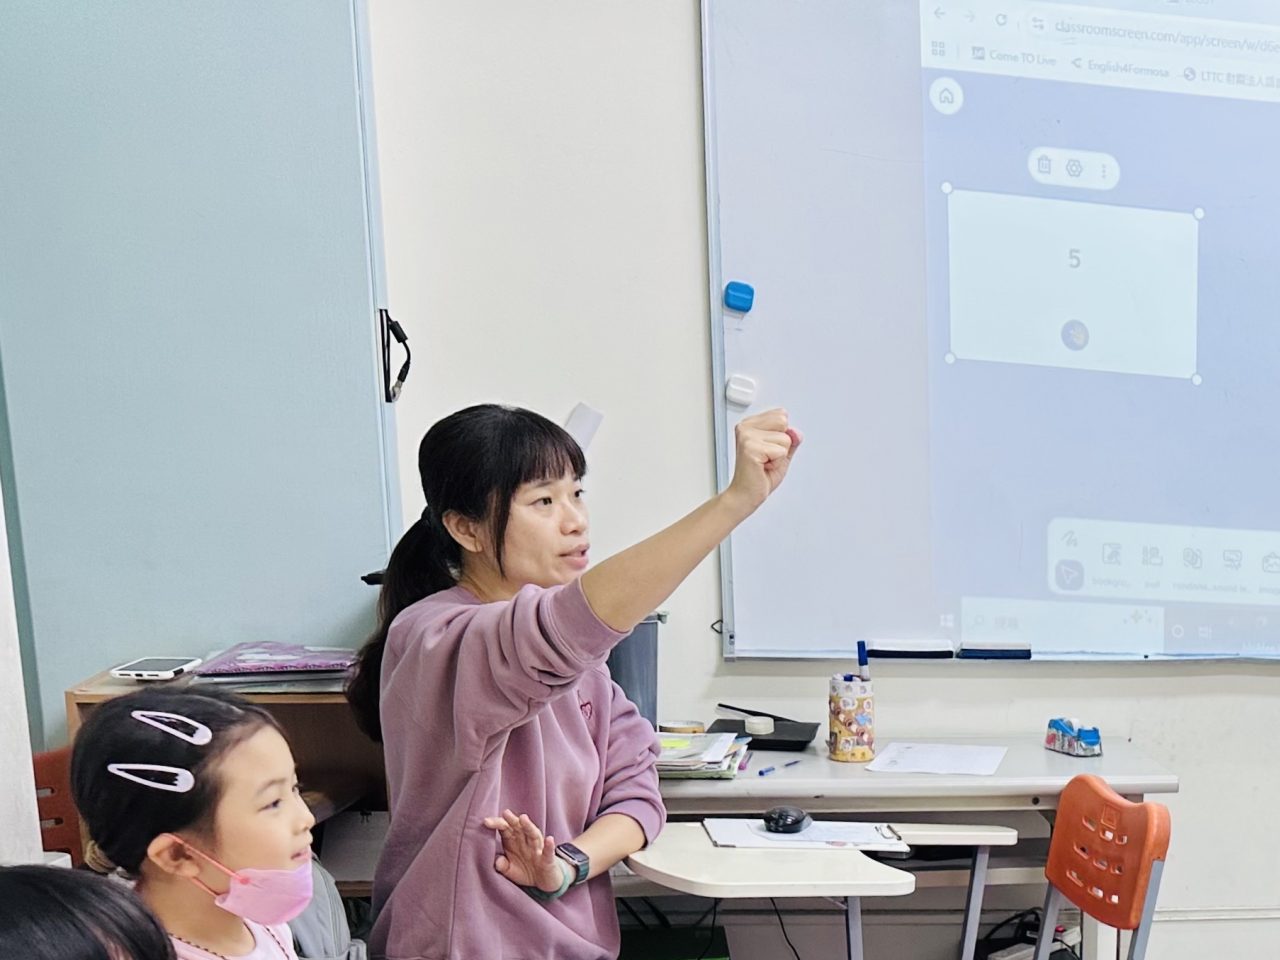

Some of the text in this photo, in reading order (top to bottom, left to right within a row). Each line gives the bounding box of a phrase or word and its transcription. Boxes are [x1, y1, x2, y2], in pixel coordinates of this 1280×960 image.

[989, 50, 1019, 63] Come
[1088, 59, 1169, 78] English4Formosa
[1069, 249, 1081, 268] 5
